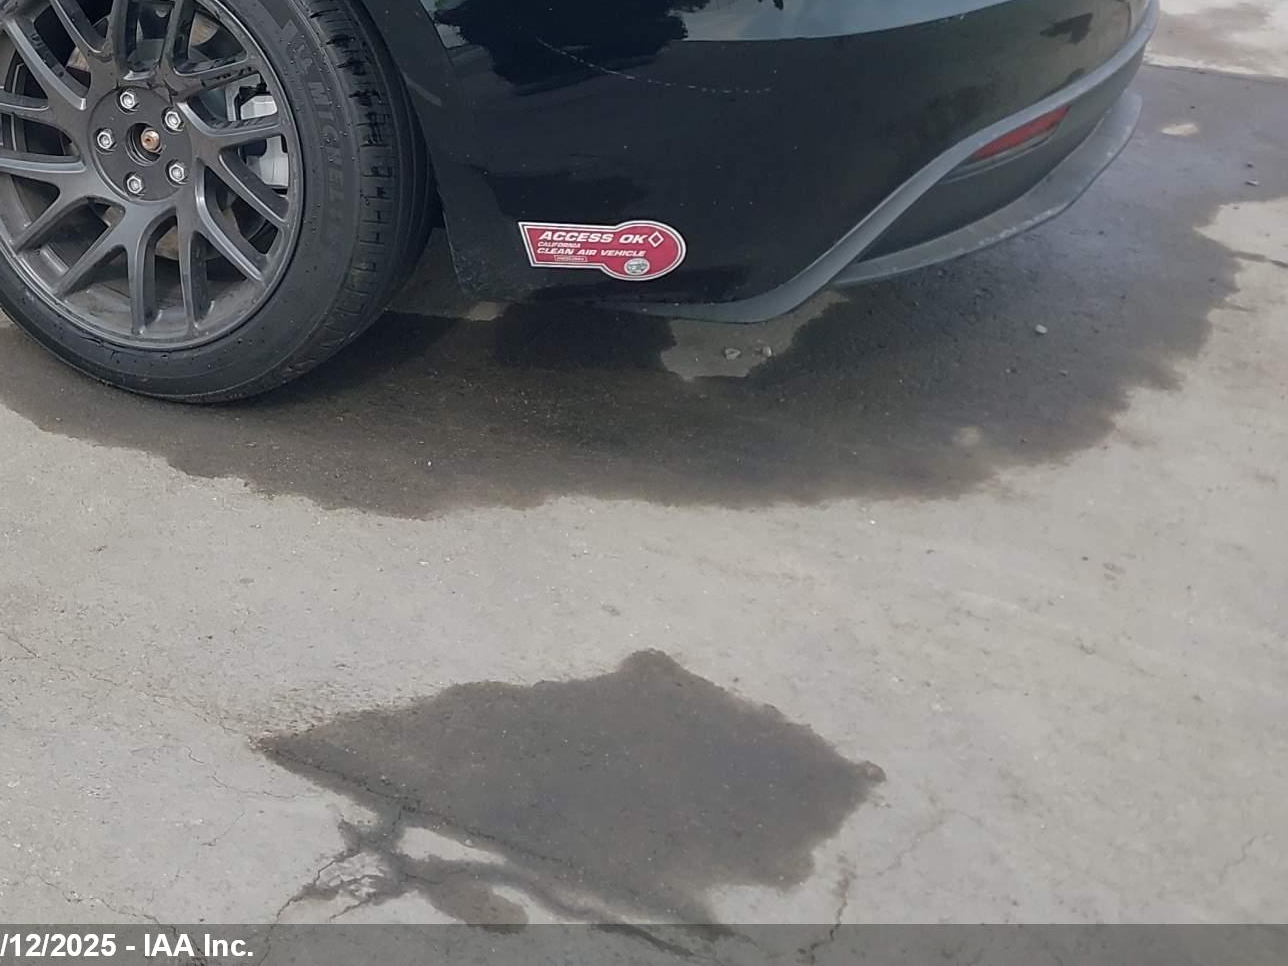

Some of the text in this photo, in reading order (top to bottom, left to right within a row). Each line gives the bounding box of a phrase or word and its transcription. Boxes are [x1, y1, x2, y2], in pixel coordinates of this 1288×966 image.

[538, 231, 649, 244] ACCESS OK
[537, 241, 582, 249] CALIFORNIA
[536, 247, 575, 256] CLEAN
[600, 249, 647, 257] VEHICLE
